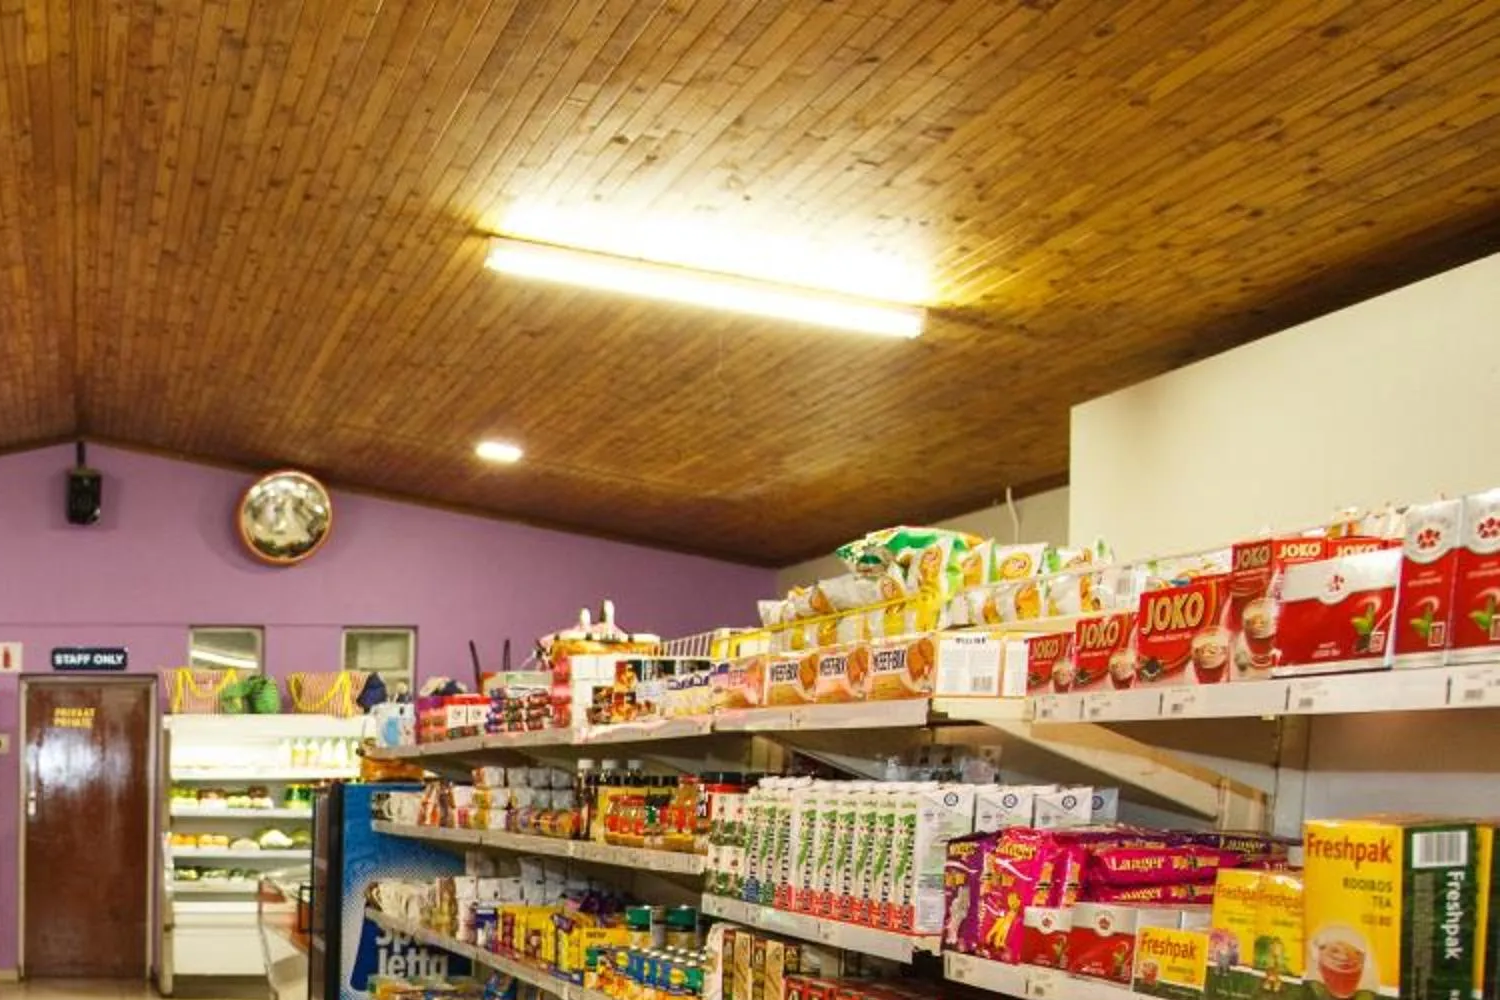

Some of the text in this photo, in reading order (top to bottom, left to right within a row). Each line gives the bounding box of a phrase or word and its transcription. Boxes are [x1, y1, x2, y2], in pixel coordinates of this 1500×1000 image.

[1236, 545, 1269, 570] JOKO
[1279, 543, 1321, 558] JOKO
[1142, 592, 1204, 636] JOKO
[1079, 621, 1119, 648] JOKO
[54, 653, 124, 665] STAFF ONLY
[1031, 638, 1059, 659] JOKO
[1306, 832, 1392, 869] Freshpak
[1342, 877, 1393, 893] ROOIBOS
[1372, 896, 1392, 908] TEA
[1441, 870, 1465, 960] Freshpak
[1141, 934, 1197, 960] Freshpak
